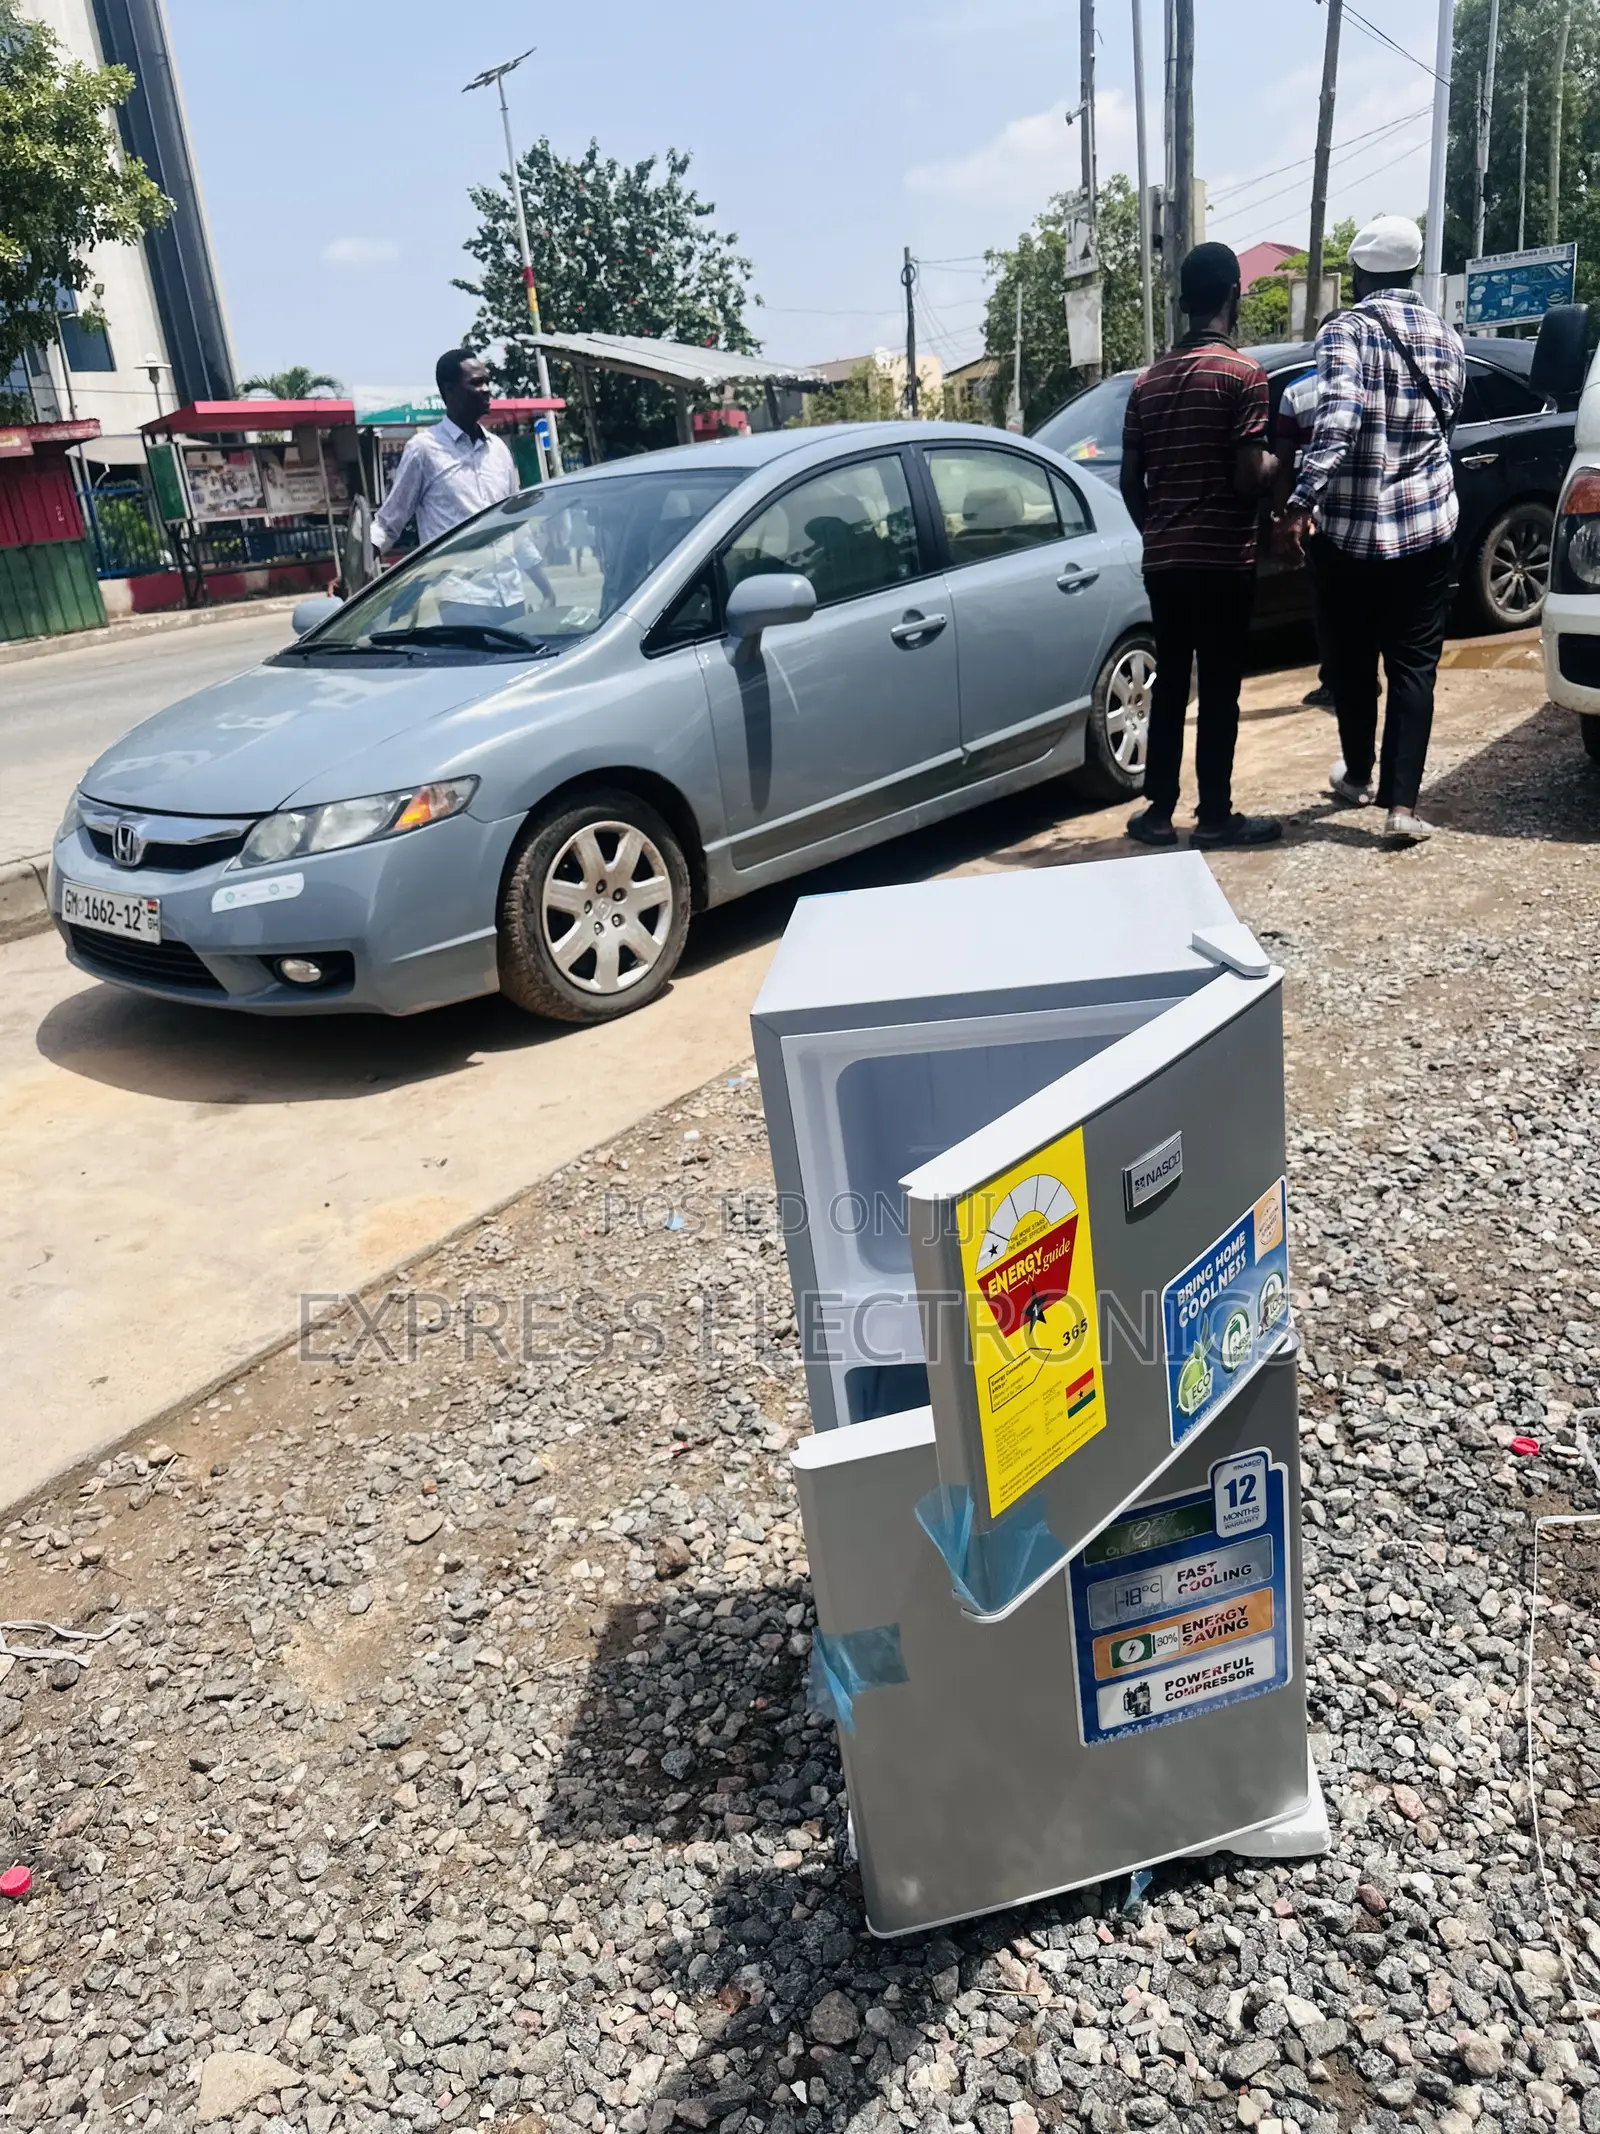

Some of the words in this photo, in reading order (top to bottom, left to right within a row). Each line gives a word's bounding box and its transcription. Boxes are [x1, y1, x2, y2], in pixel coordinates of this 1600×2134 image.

[65, 889, 78, 917] GM
[84, 895, 141, 932] 1662-12
[1147, 1150, 1180, 1186] NASCO
[1016, 1235, 1027, 1247] MORE
[1019, 1225, 1030, 1238] MORE
[988, 1247, 1043, 1298] ENERGY
[1043, 1238, 1070, 1271] guide
[1177, 1263, 1213, 1307] BRING
[1215, 1230, 1245, 1272] HOME
[1178, 1249, 1246, 1328] COOLNESS
[1033, 1304, 1038, 1317] 1
[1062, 1318, 1088, 1346] 365
[1192, 1372, 1211, 1398] ECO
[1237, 1459, 1261, 1469] NASCO
[1224, 1474, 1257, 1508] 12
[1223, 1505, 1260, 1522] MONTHS
[1224, 1515, 1259, 1530] WARRANTY
[1177, 1561, 1217, 1582] FAST
[1177, 1564, 1252, 1595] COOLING
[1182, 1605, 1248, 1635] ENERGY
[1183, 1617, 1249, 1646] SAVING
[1156, 1633, 1179, 1649] 30%
[1164, 1656, 1254, 1693] POWERFUL
[1165, 1667, 1255, 1702] COMPRESSOR
